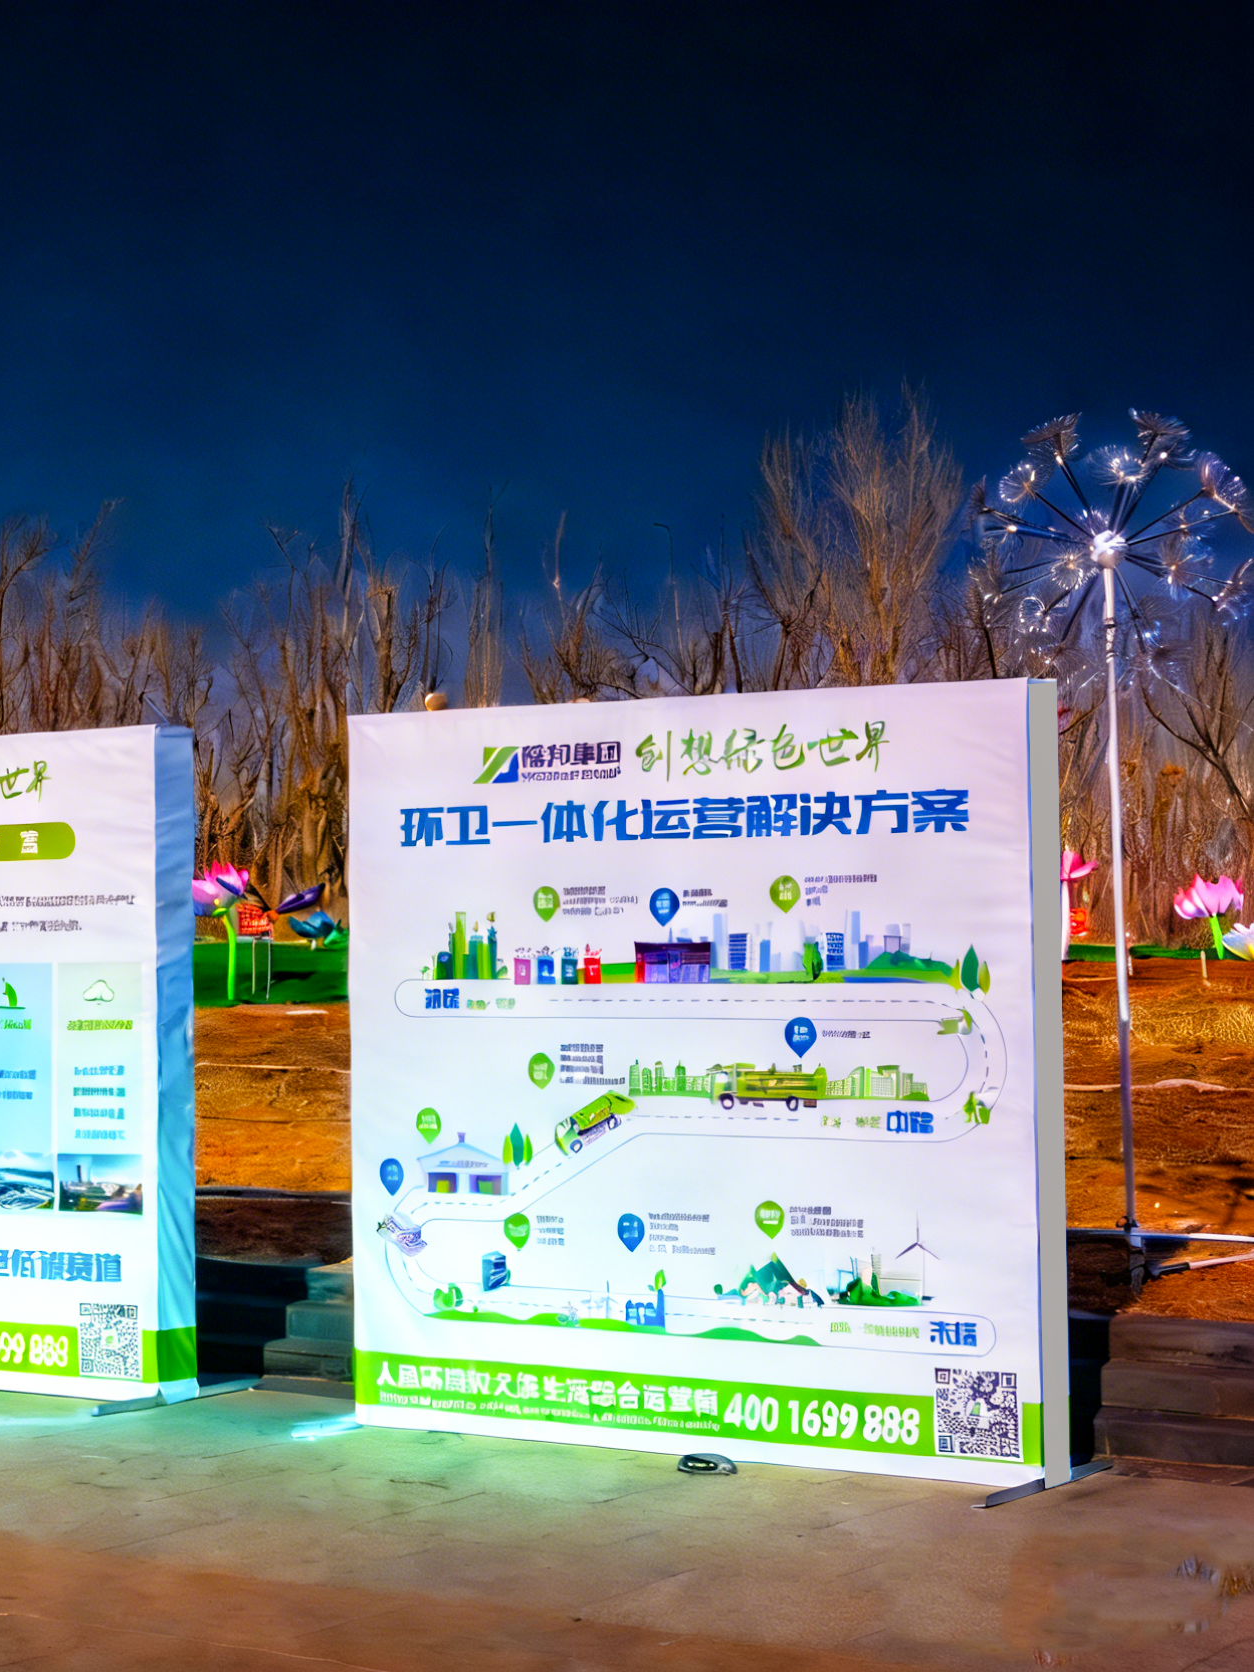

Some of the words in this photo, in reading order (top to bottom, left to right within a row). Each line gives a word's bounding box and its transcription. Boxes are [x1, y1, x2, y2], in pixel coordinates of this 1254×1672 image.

[400, 789, 970, 847] 环卫一体化运营解决方案
[724, 1393, 779, 1432] 400
[863, 1405, 920, 1445] 888
